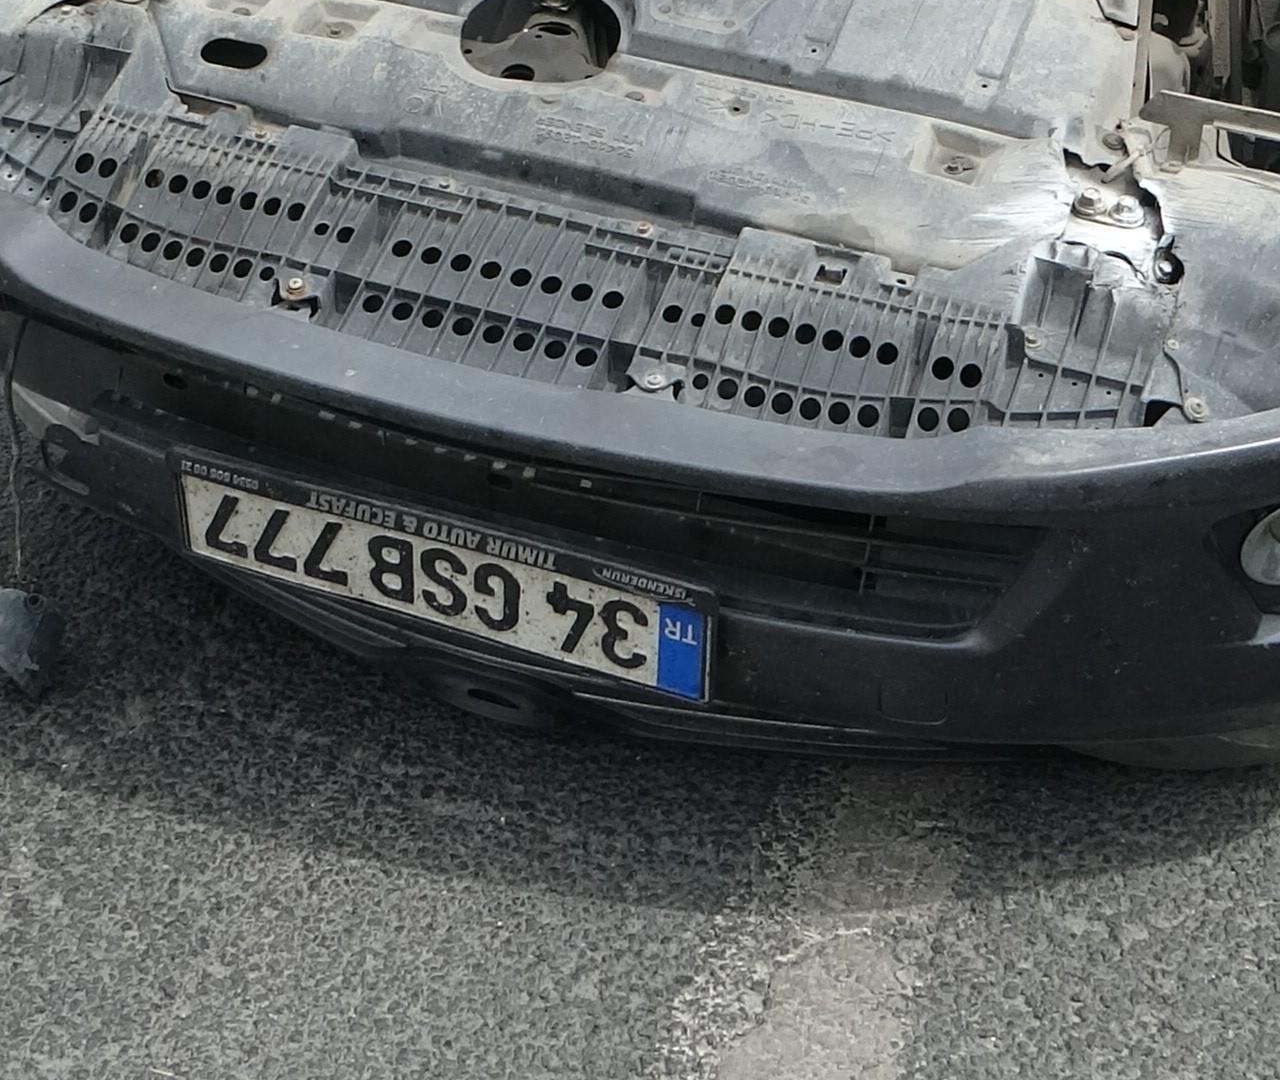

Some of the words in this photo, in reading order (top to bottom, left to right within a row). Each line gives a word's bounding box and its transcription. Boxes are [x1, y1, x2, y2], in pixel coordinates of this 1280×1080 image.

[306, 490, 395, 528] ECUFAST
[402, 512, 418, 533] &
[205, 494, 349, 587] 777
[423, 520, 483, 549] AUTO
[368, 534, 521, 632] GSB
[546, 581, 649, 669] 34
[664, 618, 698, 645] TR
